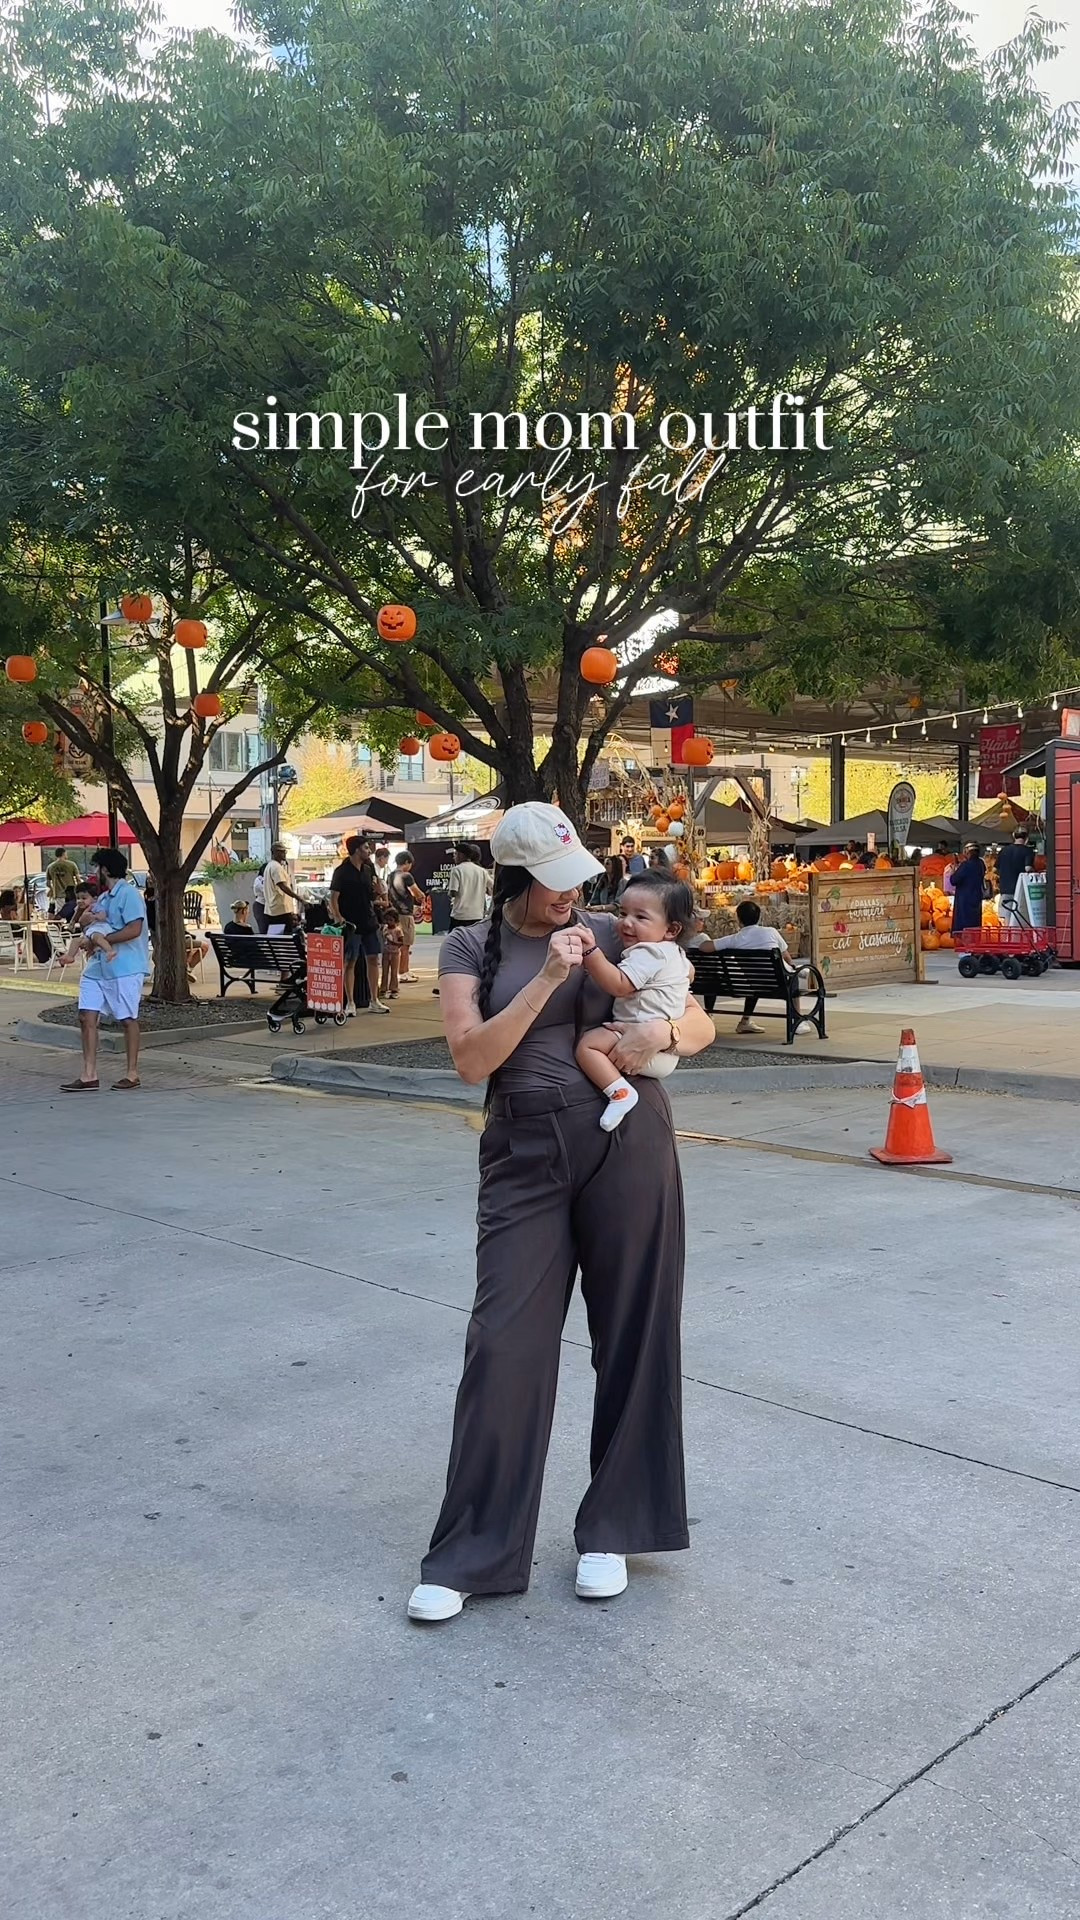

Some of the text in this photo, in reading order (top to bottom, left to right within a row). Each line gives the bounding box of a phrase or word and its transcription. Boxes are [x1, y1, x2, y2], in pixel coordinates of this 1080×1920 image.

[981, 737, 1018, 753] Hand
[832, 933, 853, 950] eat
[321, 960, 336, 968] DALLAS
[325, 968, 341, 976] MARKET
